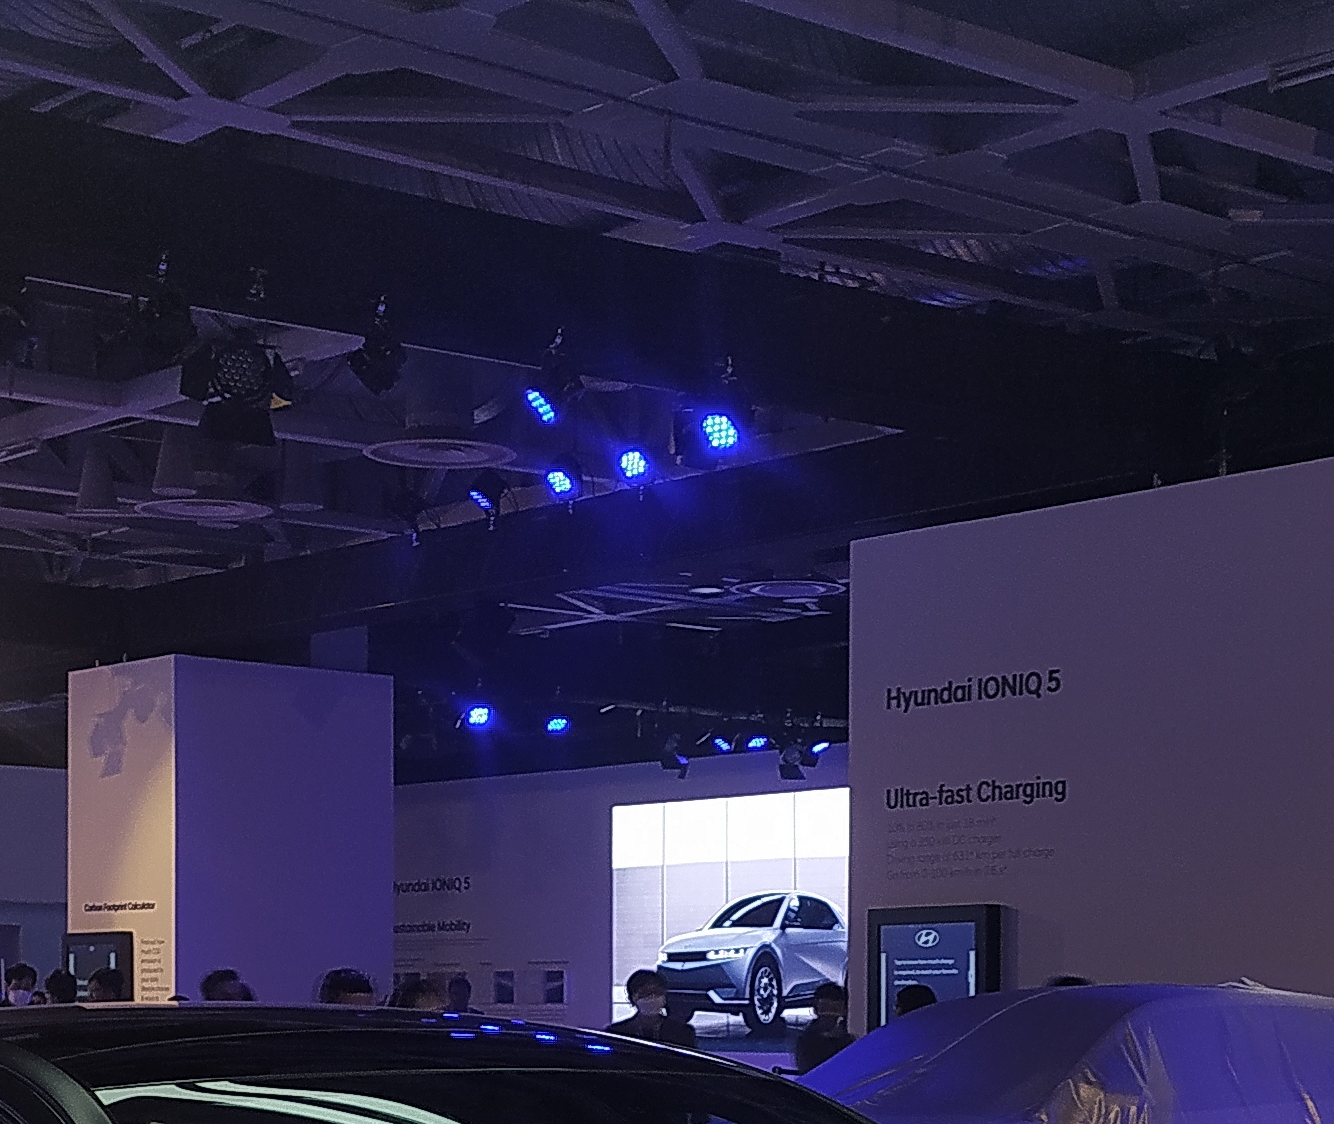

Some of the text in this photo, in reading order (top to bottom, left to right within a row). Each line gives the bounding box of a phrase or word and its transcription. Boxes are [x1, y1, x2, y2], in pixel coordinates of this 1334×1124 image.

[886, 668, 1061, 714] Hyundai IONIQ 5
[885, 775, 1067, 810] Ultra-fast Charging
[463, 876, 471, 890] 5
[437, 919, 471, 934] Mobility
